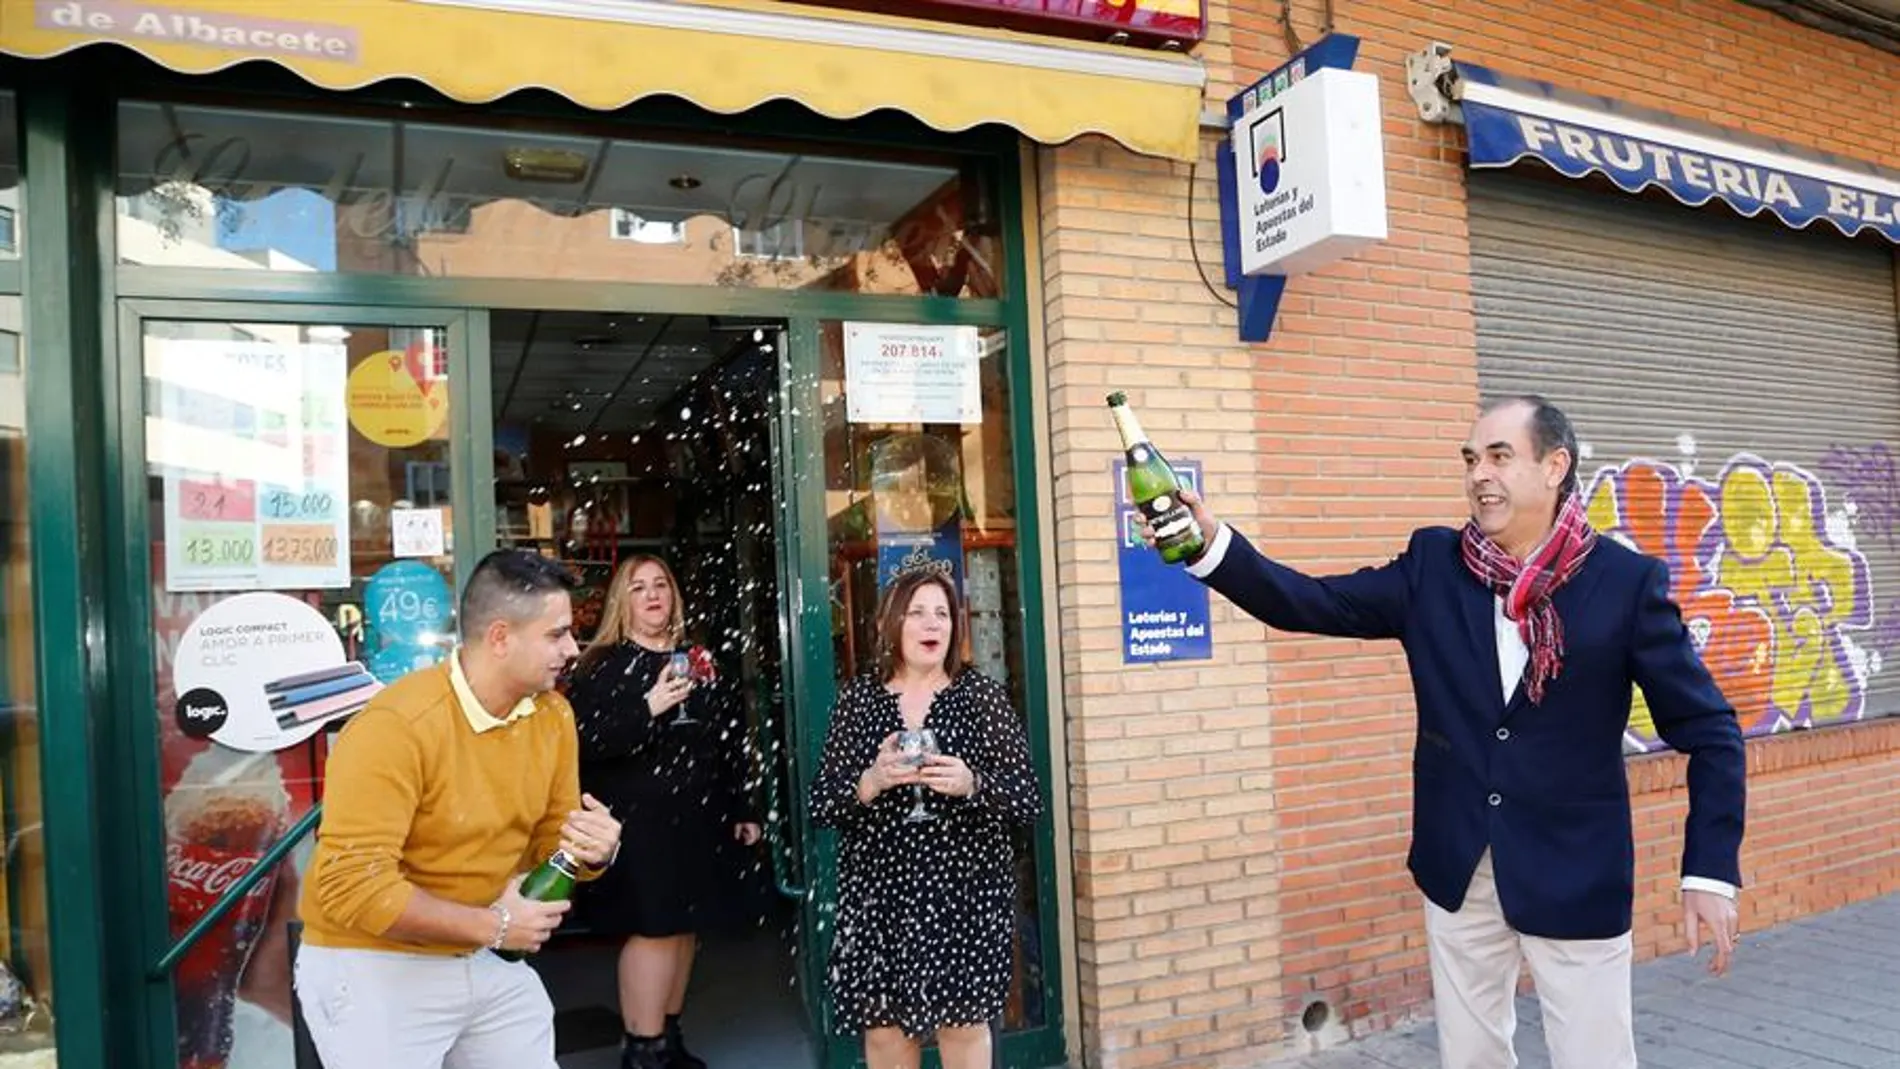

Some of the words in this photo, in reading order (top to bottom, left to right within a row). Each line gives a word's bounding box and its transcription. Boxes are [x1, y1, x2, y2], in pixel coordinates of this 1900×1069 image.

[51, 2, 116, 30] de
[133, 11, 348, 56] Albacete
[1516, 115, 1802, 210] FRUTERIA
[1255, 206, 1298, 236] Apuestas
[1298, 193, 1314, 215] del
[1256, 228, 1288, 253] Estado
[379, 589, 440, 622] 49€
[200, 626, 234, 637] LOGIC
[236, 622, 289, 635] COMPACT
[1130, 625, 1185, 643] Apuestas
[1186, 622, 1205, 638] del
[200, 636, 248, 651] AMOR
[1131, 641, 1172, 656] Estado
